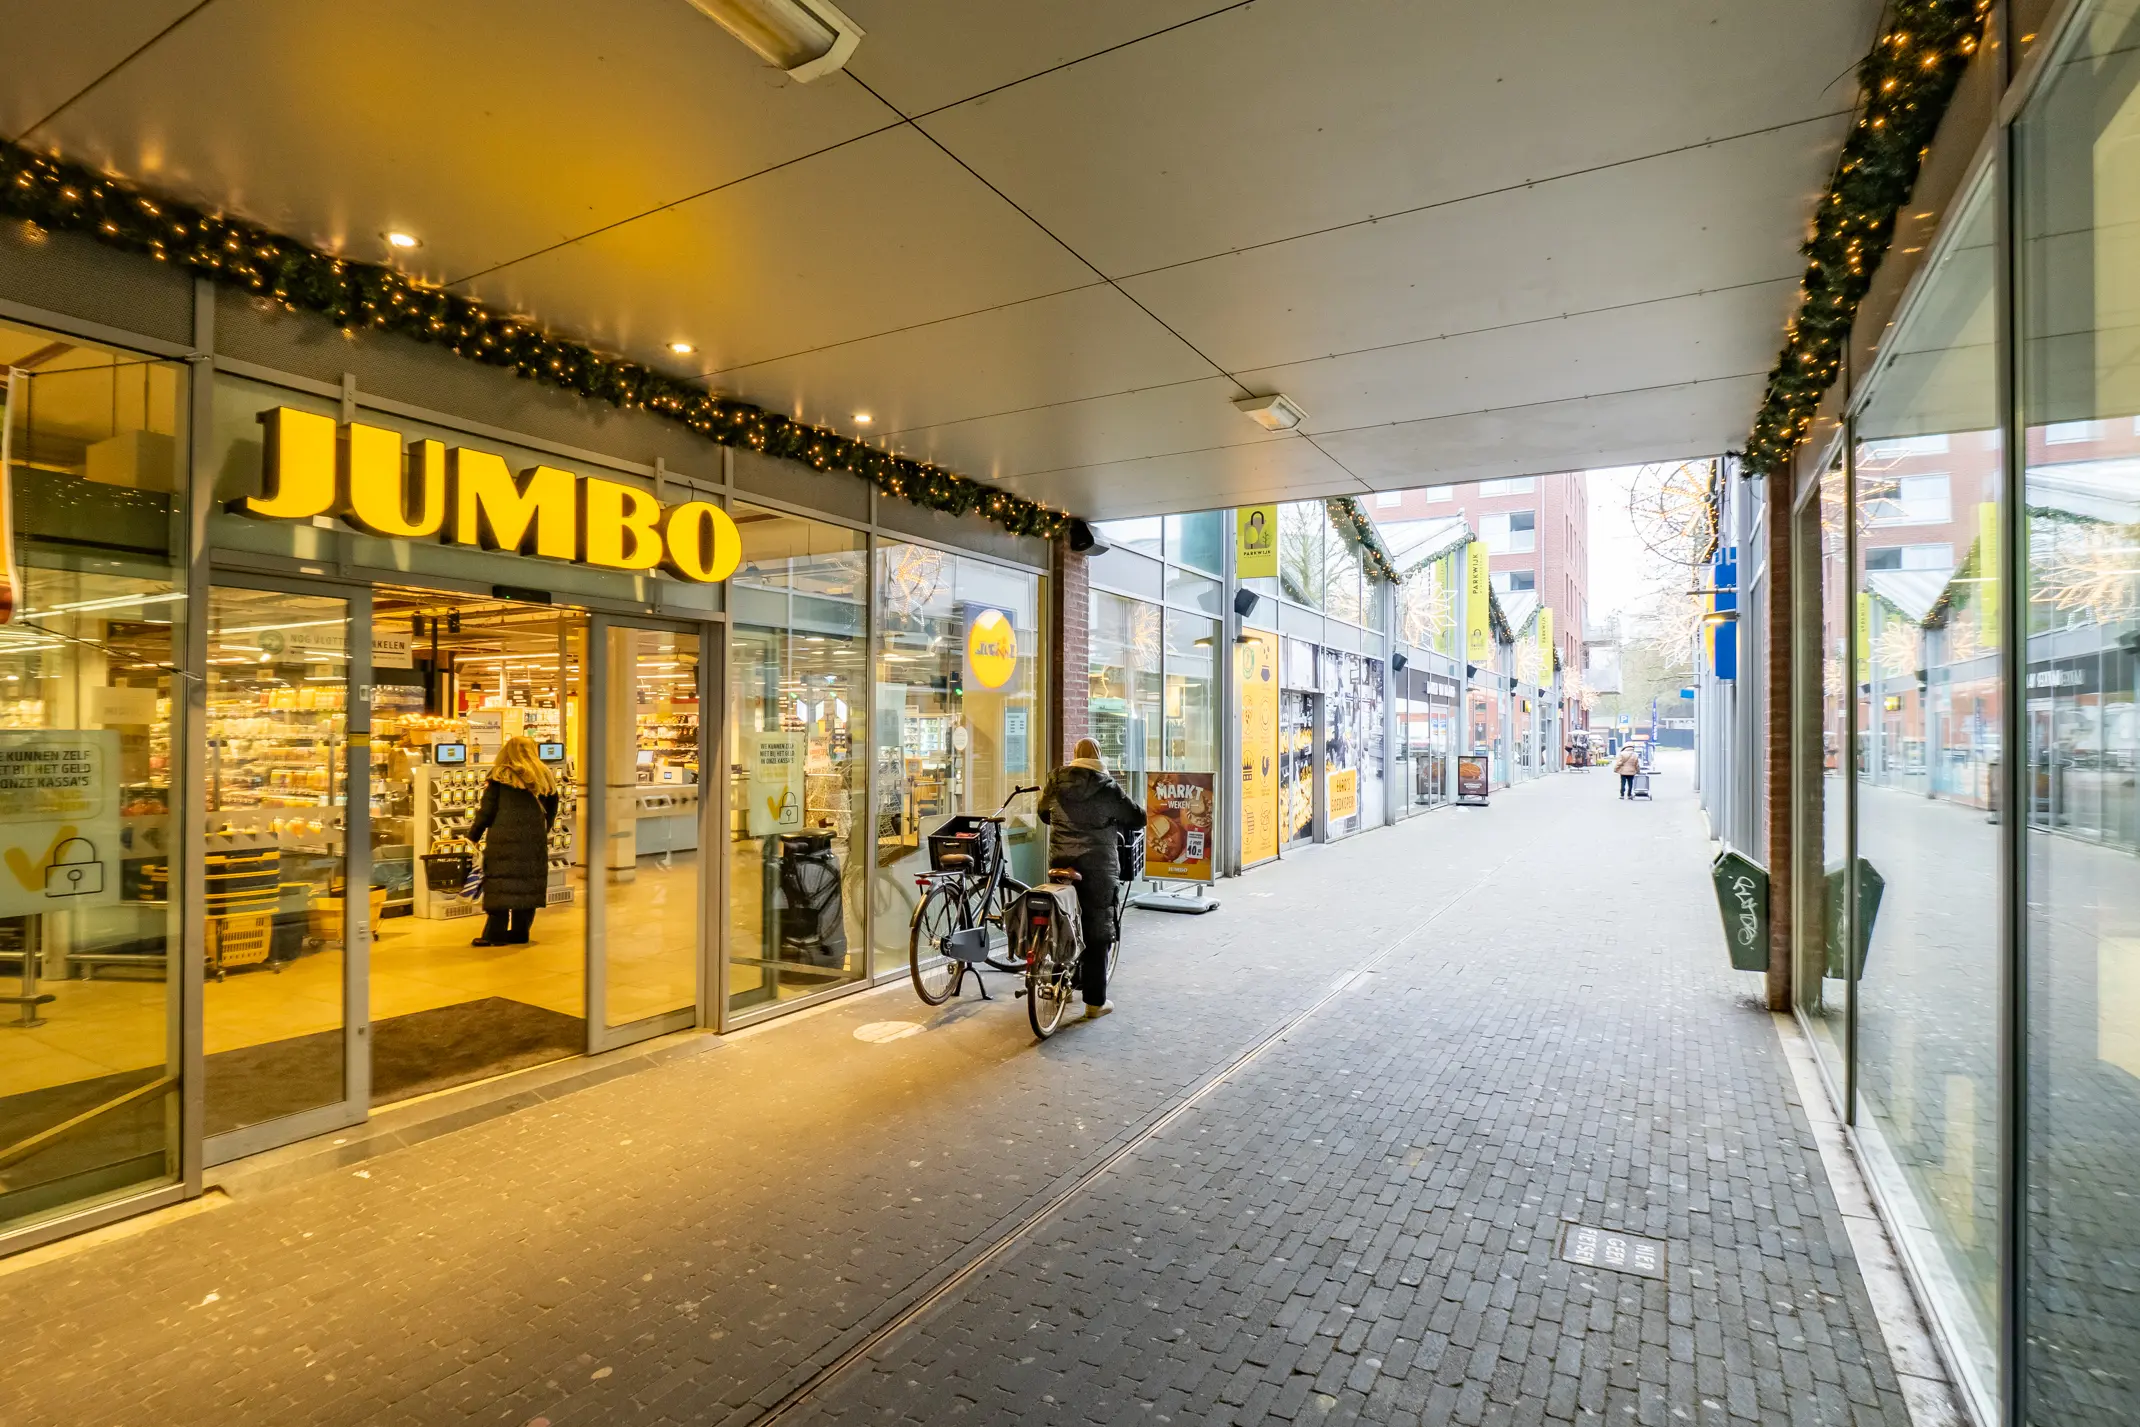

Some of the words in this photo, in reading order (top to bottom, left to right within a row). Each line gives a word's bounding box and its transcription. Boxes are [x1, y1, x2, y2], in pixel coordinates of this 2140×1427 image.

[246, 405, 742, 583] JUMBO
[6, 751, 59, 762] KUNNEN
[63, 750, 90, 760] ZELF
[35, 764, 58, 774] HET
[62, 763, 91, 774] GELD
[38, 776, 89, 787] KASSA'S
[1155, 782, 1204, 801] MARKT
[1168, 801, 1190, 809] WEKEN
[1576, 1227, 1597, 1265] FIETSEN
[1605, 1238, 1626, 1266] GEEN
[1635, 1244, 1655, 1270] HIER
